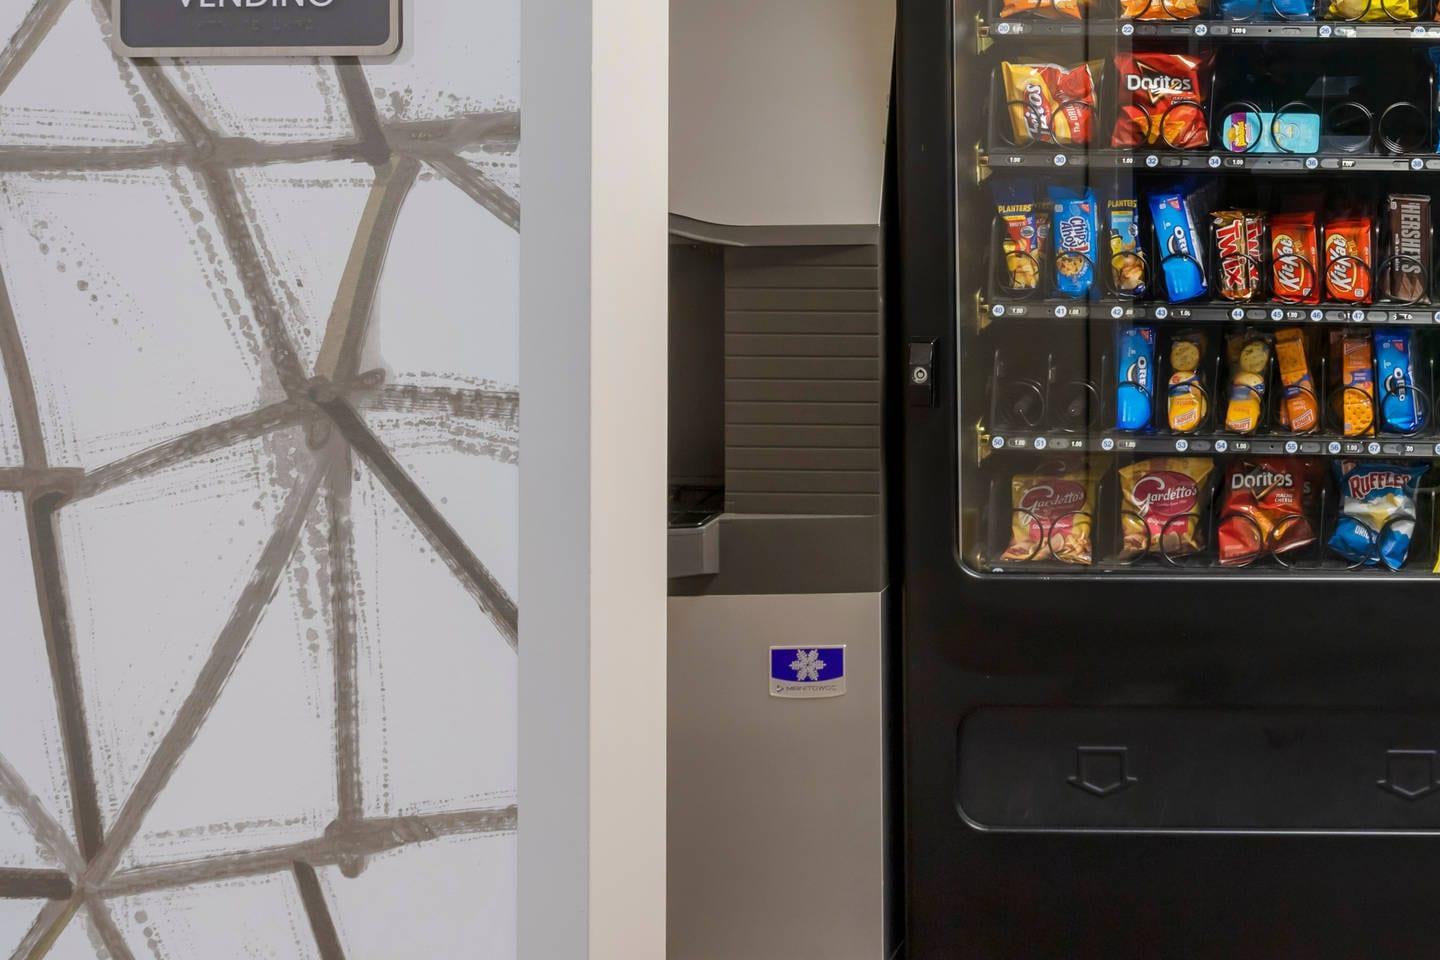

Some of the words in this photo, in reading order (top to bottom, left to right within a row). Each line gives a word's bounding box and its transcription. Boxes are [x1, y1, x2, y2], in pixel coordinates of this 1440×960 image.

[1127, 74, 1192, 92] Doritos
[998, 204, 1032, 213] PLANTERS
[1174, 226, 1189, 261] ORE
[1401, 203, 1421, 274] HERSHEYS
[1231, 472, 1293, 489] Doritos
[1131, 476, 1197, 517] Gardetto's
